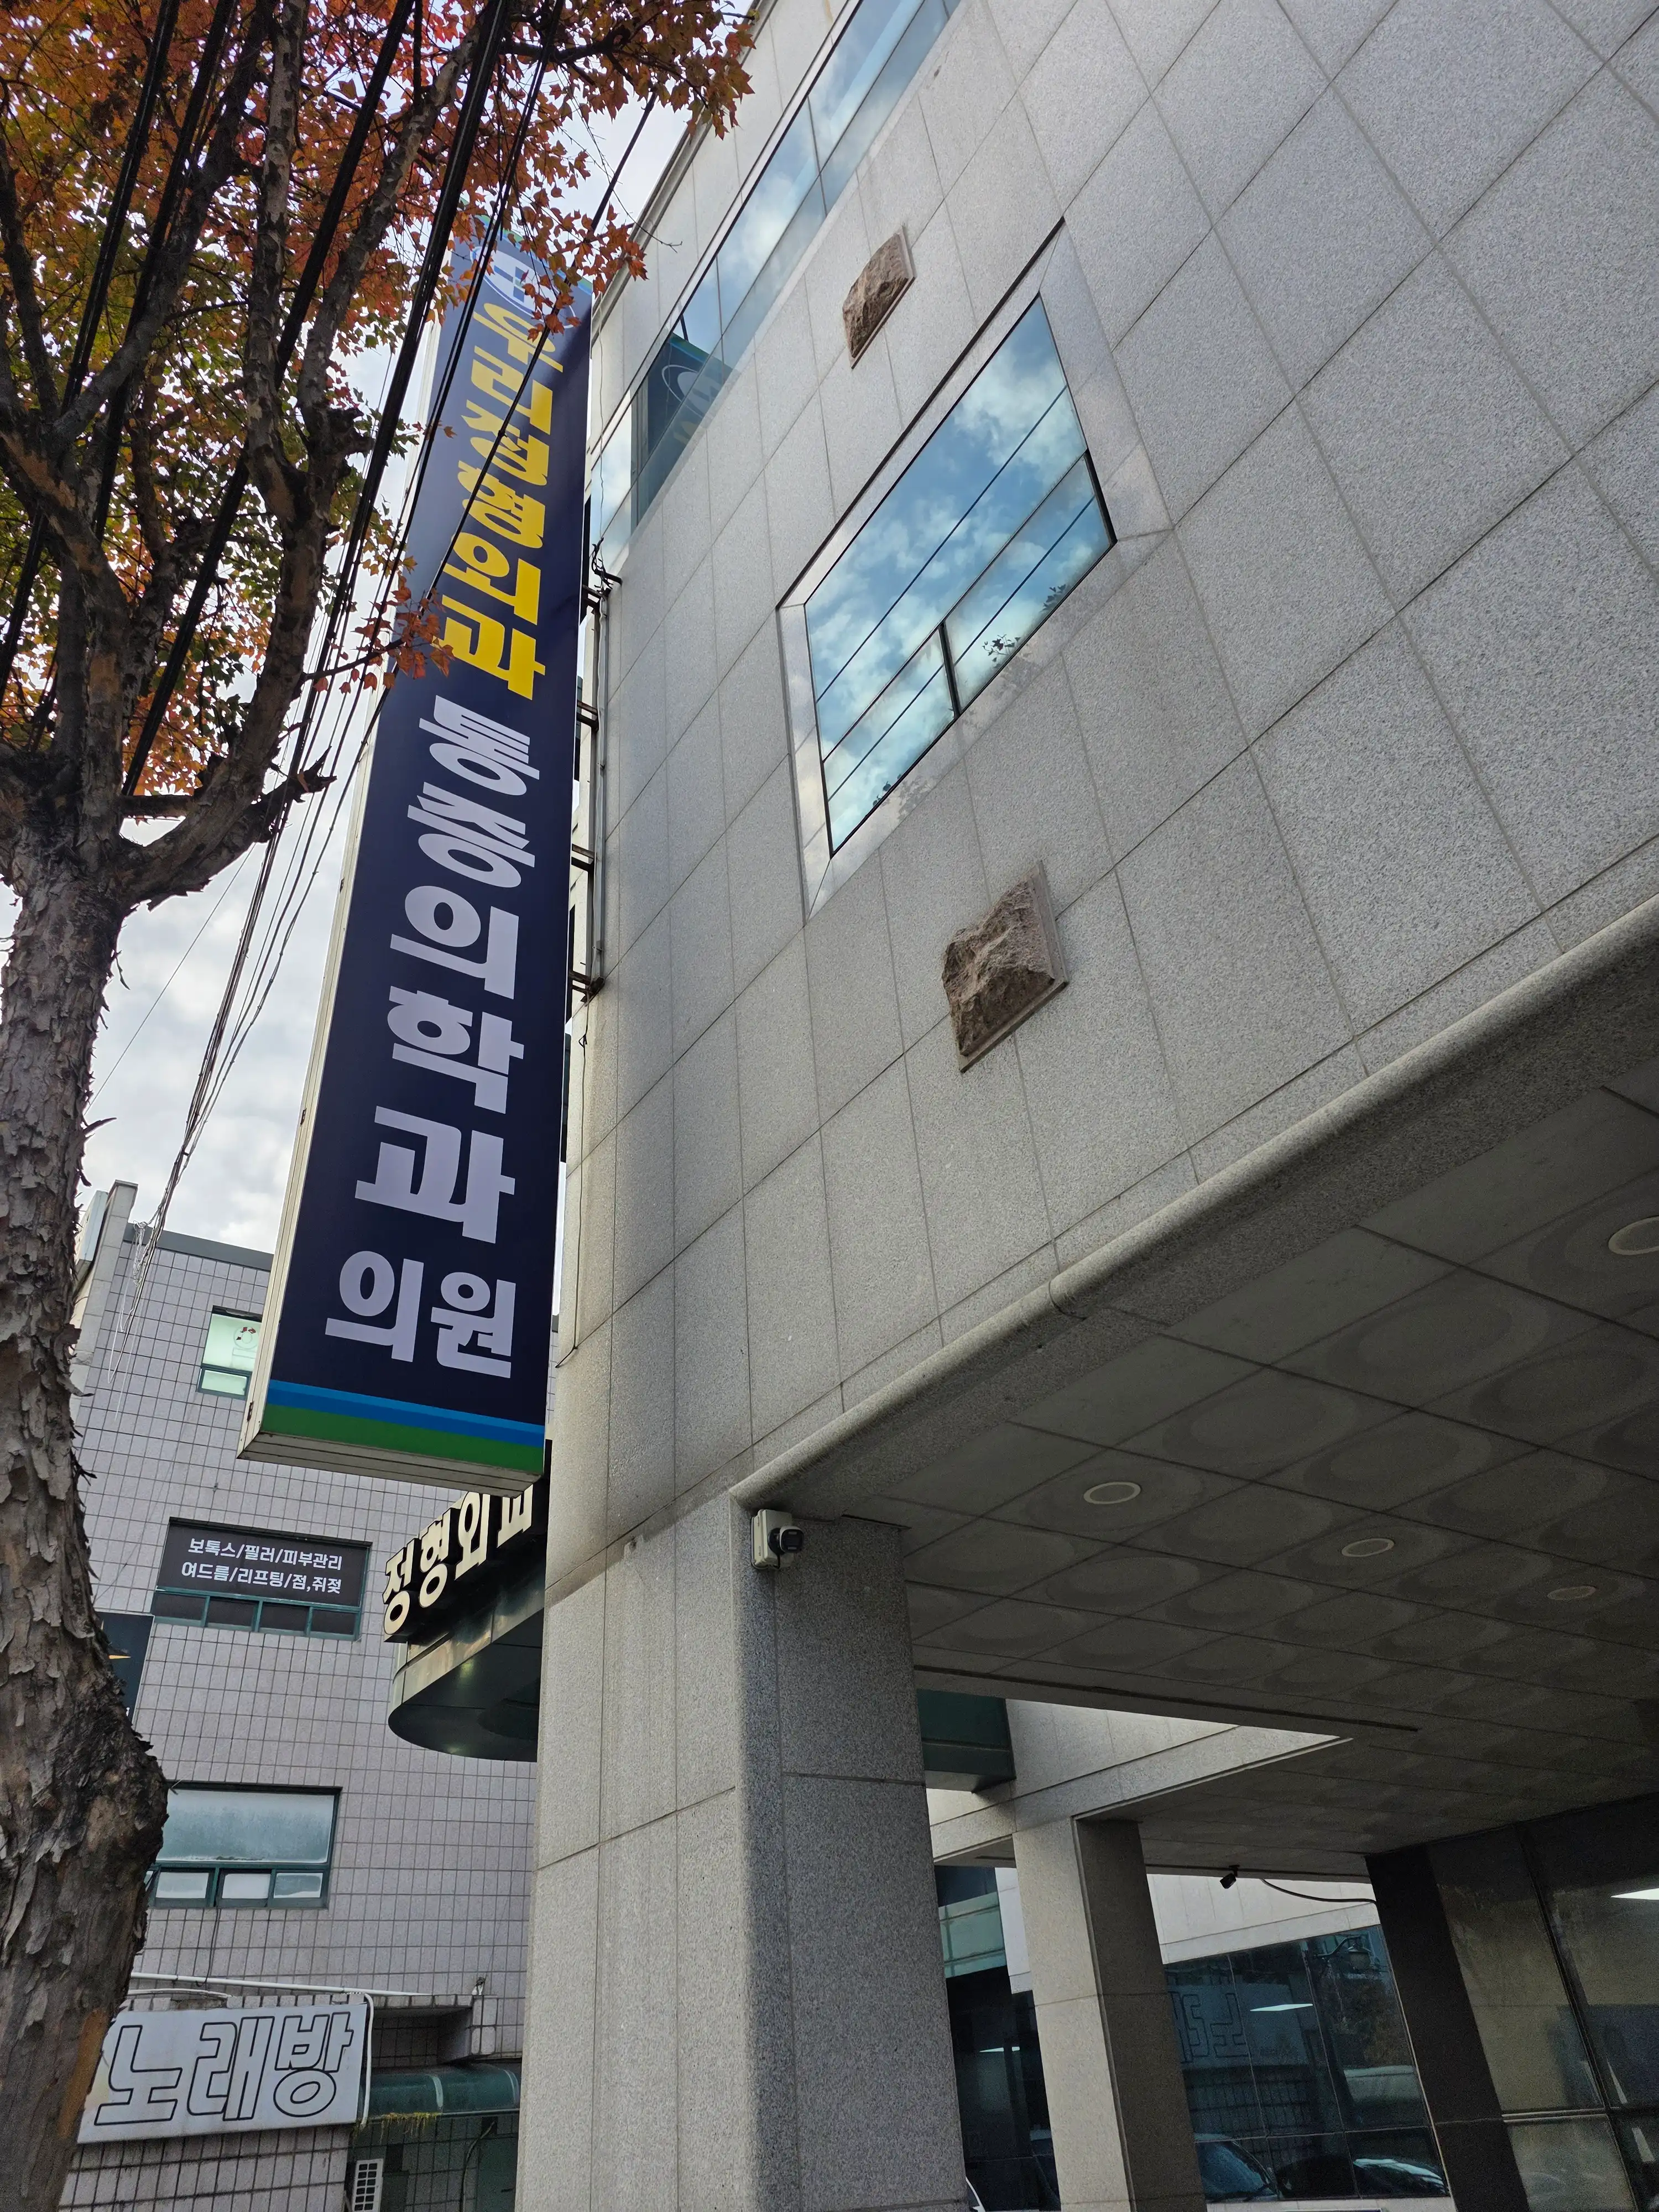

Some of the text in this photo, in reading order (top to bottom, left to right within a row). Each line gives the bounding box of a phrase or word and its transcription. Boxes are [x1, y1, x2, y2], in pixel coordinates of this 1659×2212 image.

[430, 303, 564, 701] 우리정형외과
[355, 695, 540, 1244] 통증의학과
[325, 1251, 516, 1379] 의원
[181, 1561, 342, 1594] 여드름/리프팅/점,쥐젖
[188, 1538, 342, 1571] 보톡스/필러/피부관리
[95, 2011, 354, 2126] 노래방
